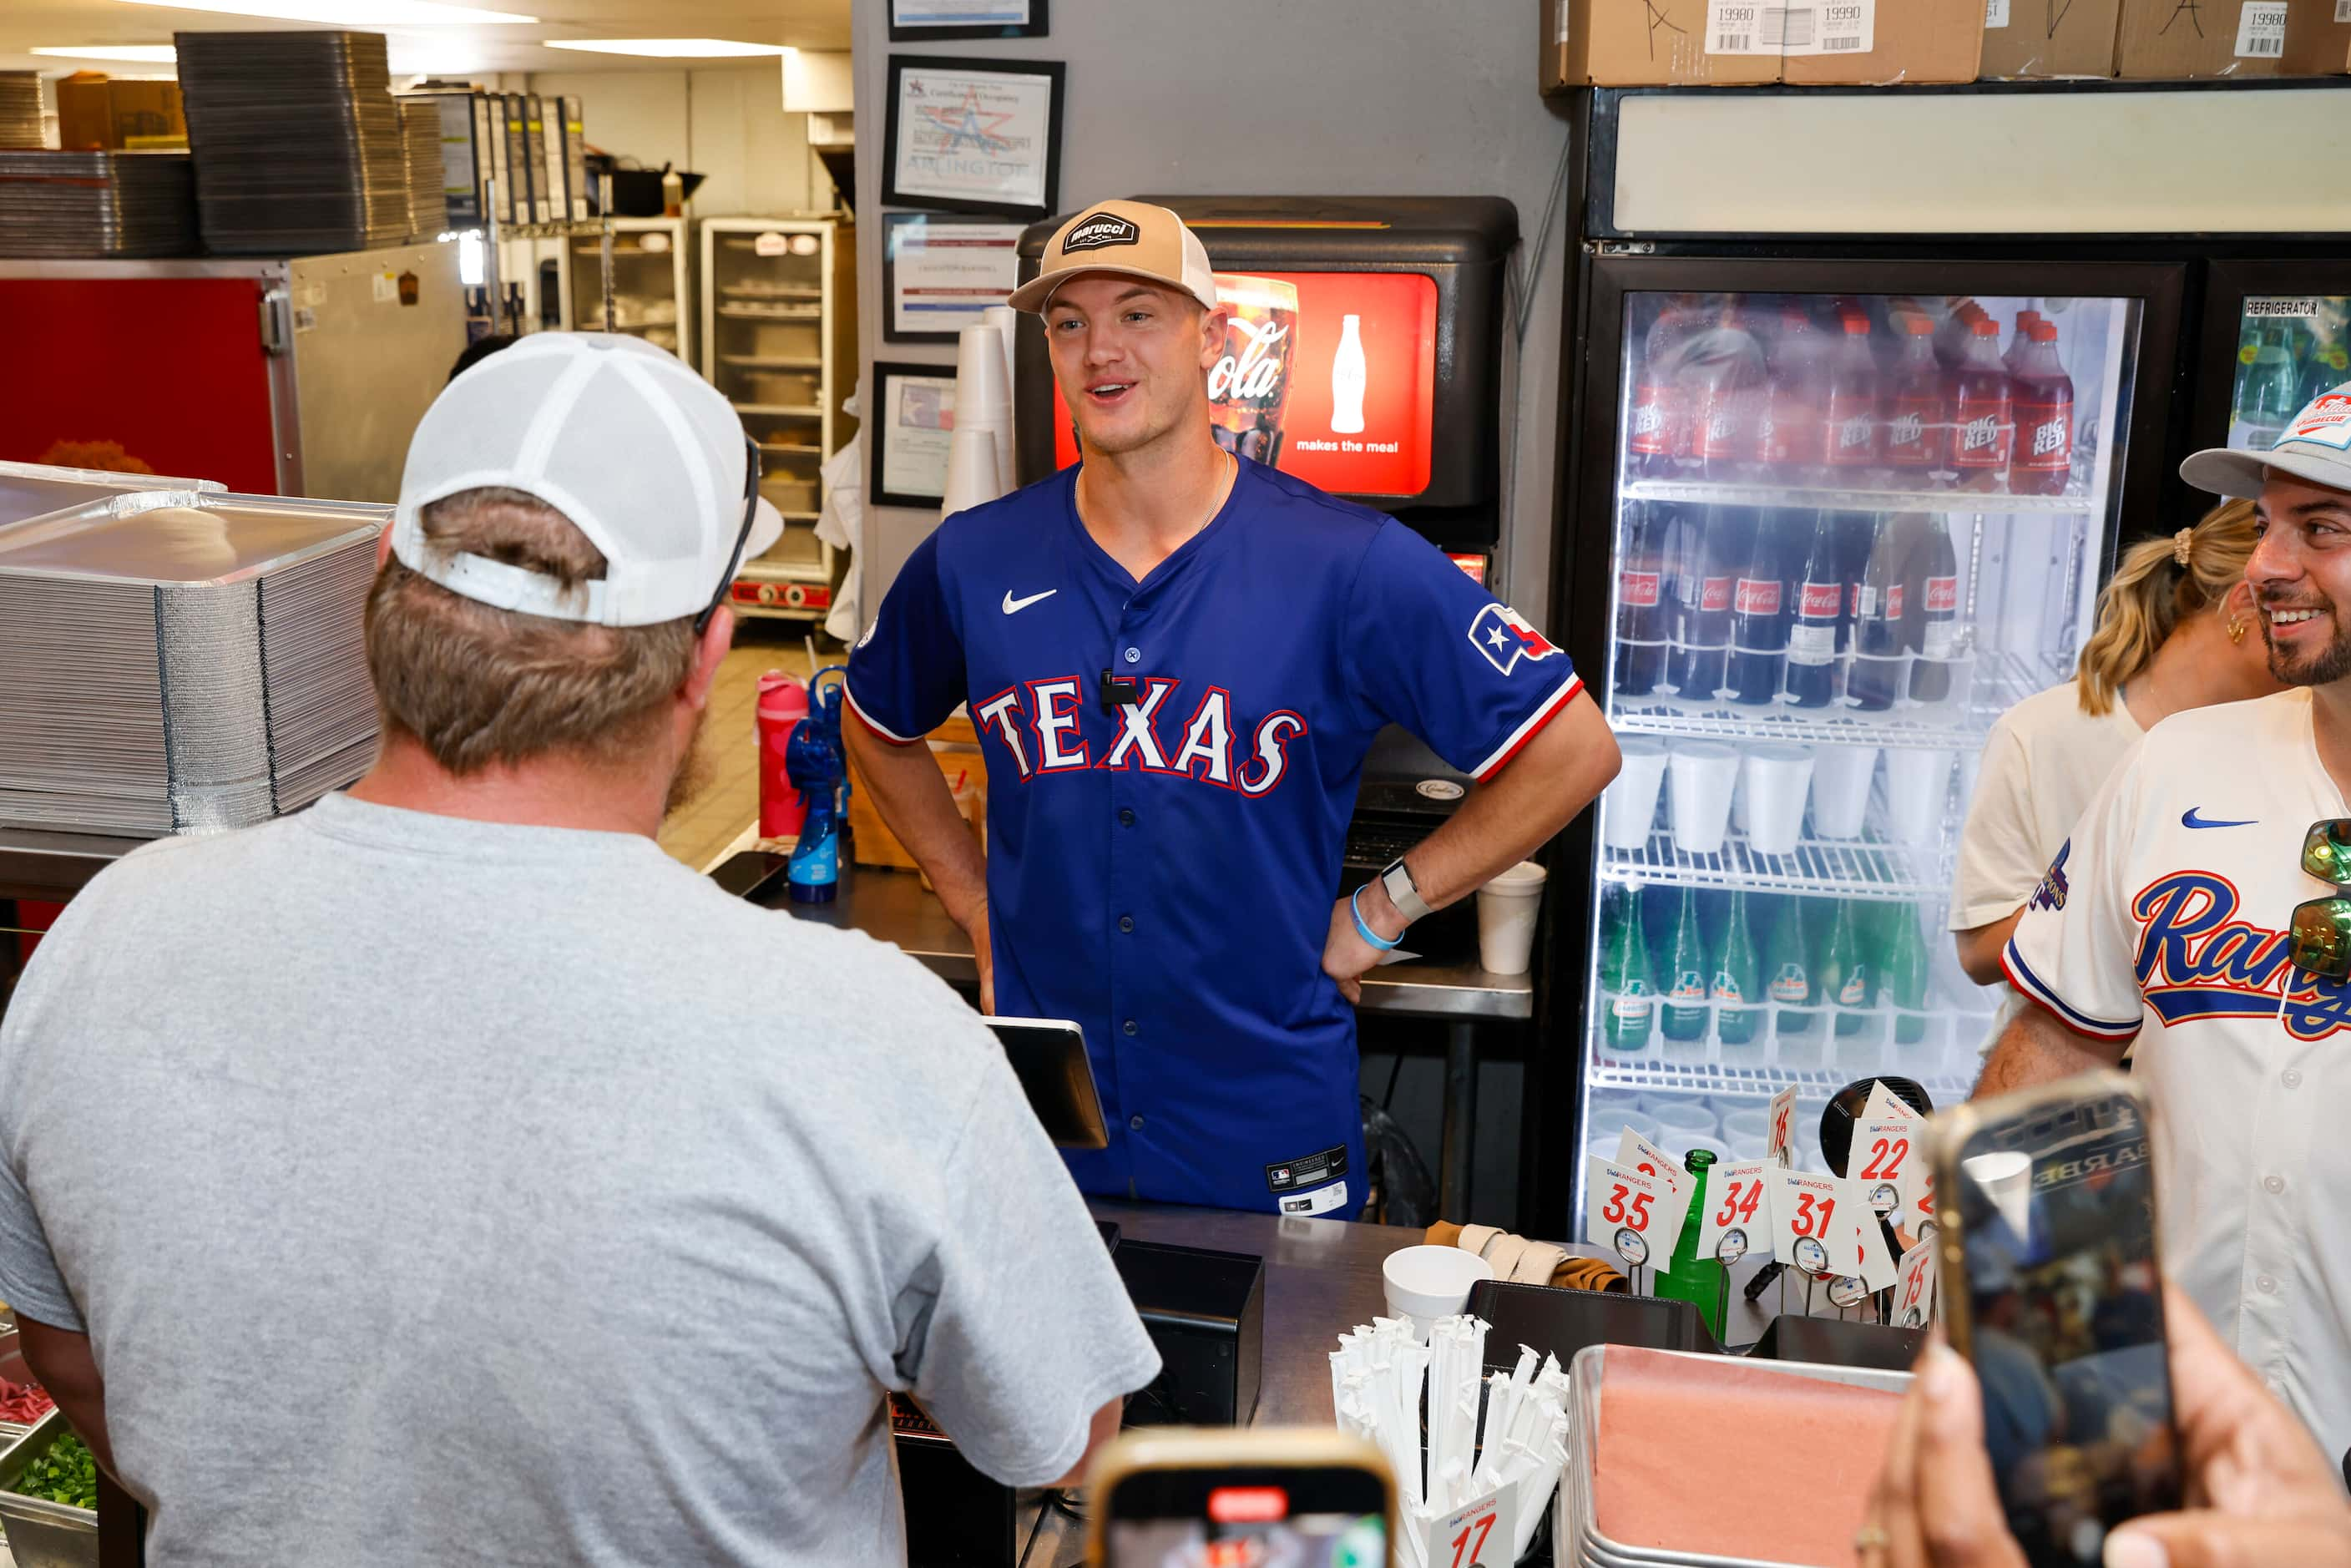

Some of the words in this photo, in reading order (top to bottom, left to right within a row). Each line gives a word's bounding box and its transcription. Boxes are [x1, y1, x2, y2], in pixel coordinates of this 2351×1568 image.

[1718, 8, 1754, 21] 19980
[1825, 6, 1861, 21] 19990
[1071, 224, 1126, 242] marucci
[2247, 300, 2318, 316] REFRIGERATOR
[1297, 439, 1337, 452] makes
[1342, 440, 1363, 452] the
[1366, 441, 1398, 453] meal
[1964, 427, 1998, 451] RED
[2033, 430, 2066, 457] RED
[2036, 417, 2065, 441] BIG
[973, 675, 1308, 799] TEXAS
[1773, 1106, 1789, 1154] 16
[1860, 1138, 1909, 1180] 22
[1603, 1183, 1655, 1232] 35
[1716, 1178, 1764, 1227] 34
[1791, 1192, 1836, 1239] 31
[1902, 1256, 1929, 1310] 15
[1451, 1512, 1497, 1568] 17
